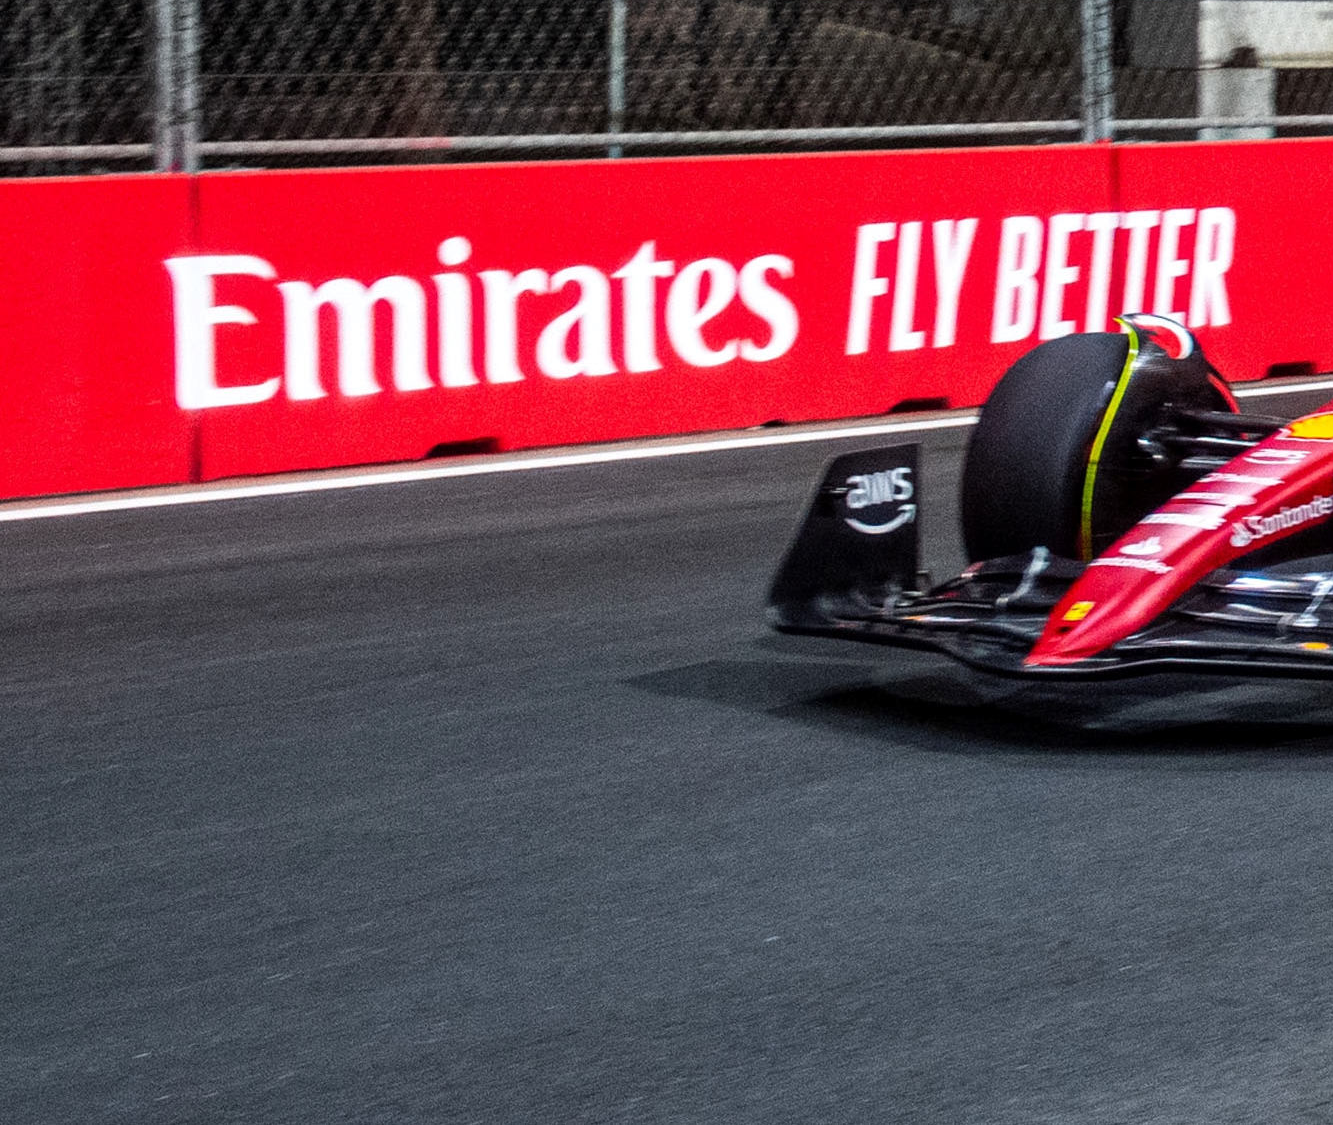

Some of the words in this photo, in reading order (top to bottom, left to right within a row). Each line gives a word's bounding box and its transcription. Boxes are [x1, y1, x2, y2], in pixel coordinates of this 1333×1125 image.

[163, 235, 800, 411] Emirates
[844, 217, 981, 356] FLY
[990, 206, 1237, 345] BETTER
[846, 467, 914, 509] aws
